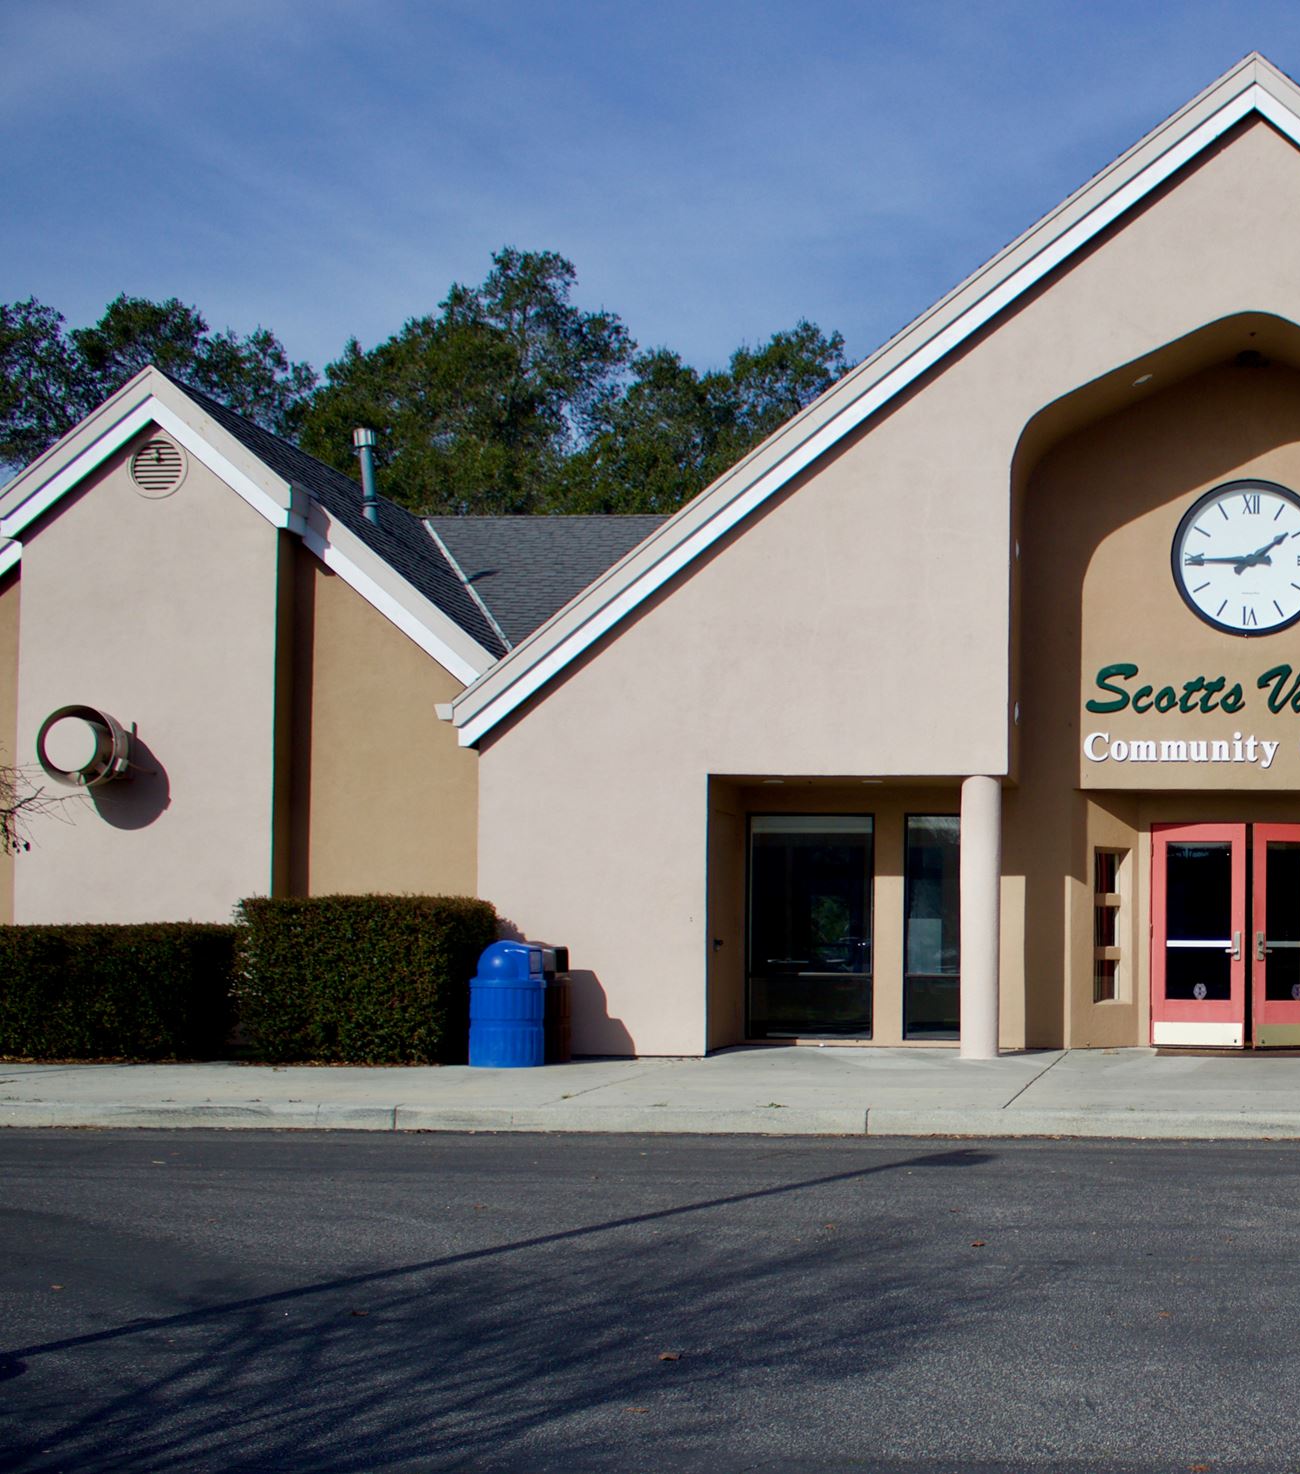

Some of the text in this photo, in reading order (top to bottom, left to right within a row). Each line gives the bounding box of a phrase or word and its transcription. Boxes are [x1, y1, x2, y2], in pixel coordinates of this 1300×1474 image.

[1242, 494, 1261, 515] XII
[1085, 663, 1246, 714] Scotts
[1083, 731, 1280, 769] Community
